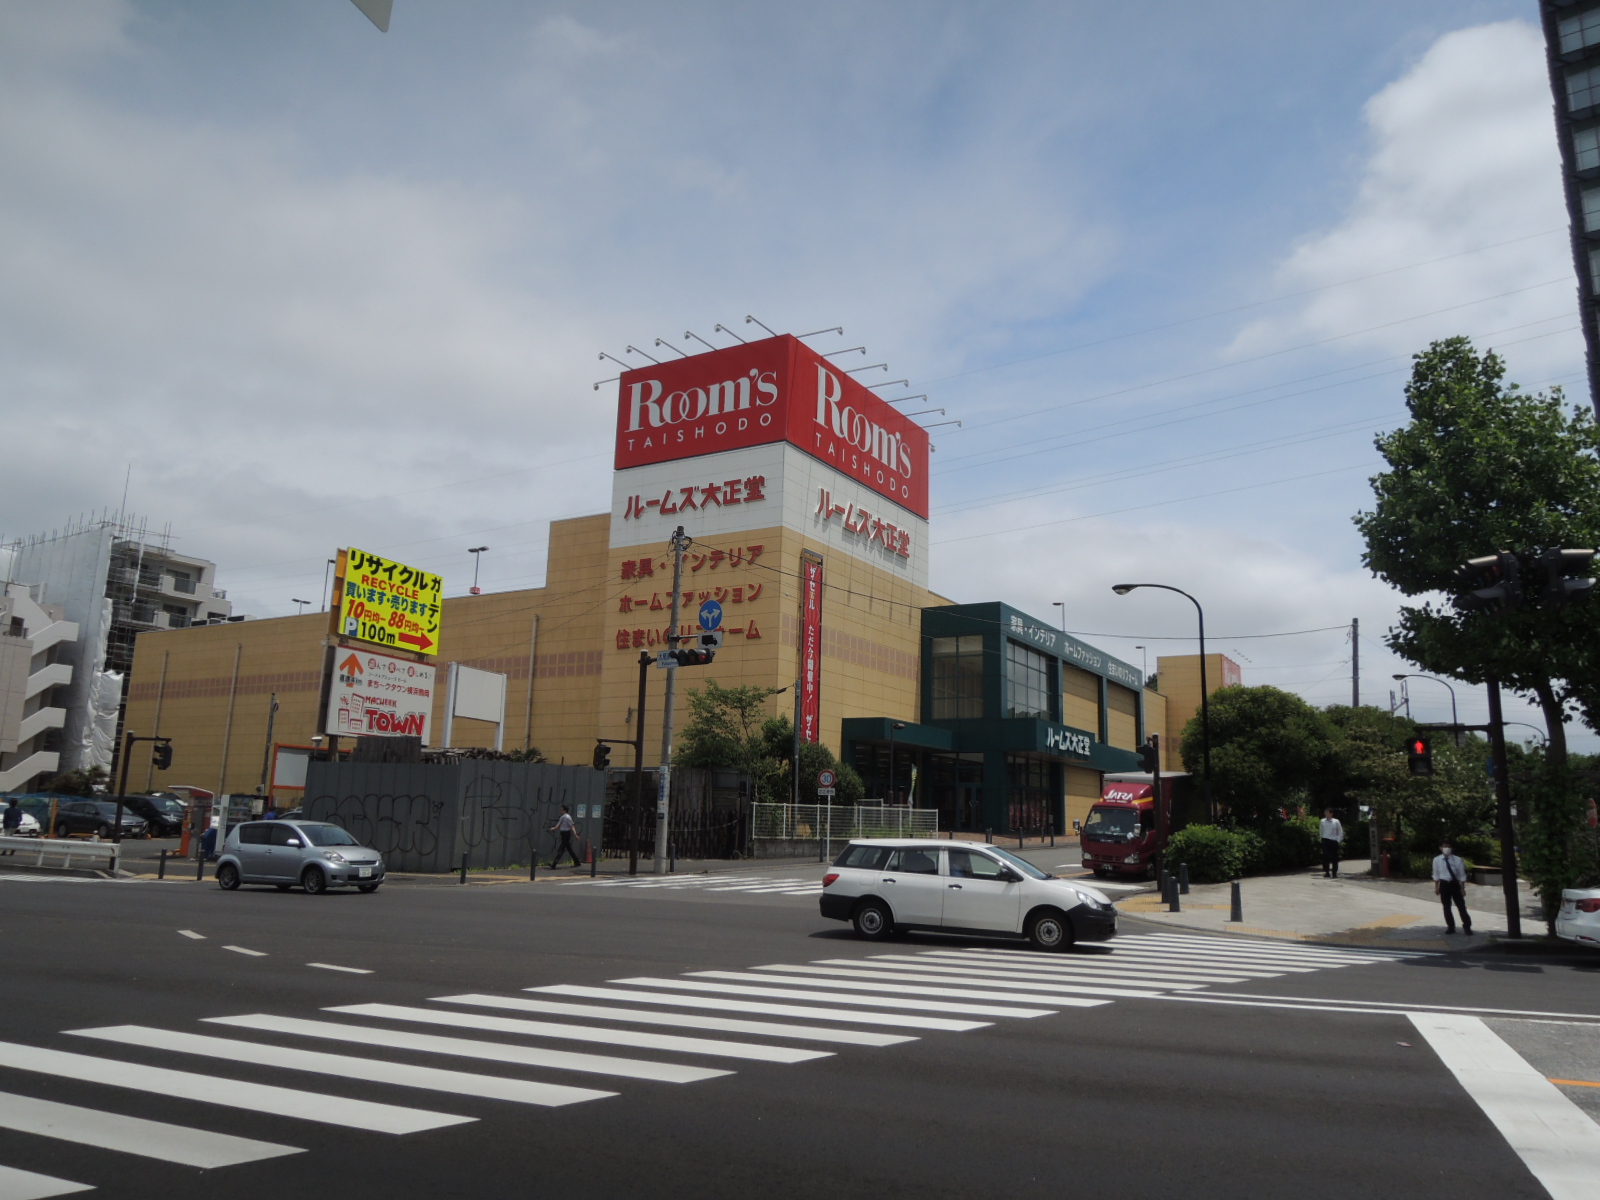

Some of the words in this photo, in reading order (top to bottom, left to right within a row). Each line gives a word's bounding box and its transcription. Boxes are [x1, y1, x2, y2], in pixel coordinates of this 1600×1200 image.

[624, 368, 778, 433] Room's
[627, 413, 772, 451] TAISHODO
[813, 361, 912, 479] Room's
[814, 432, 909, 499] TAISHODO
[624, 475, 766, 520] ルームズ大正堂
[815, 487, 911, 559] ルームズ大正堂
[345, 582, 428, 617] 買います・売ります
[350, 549, 429, 591] リサイクル
[426, 577, 442, 633] ガーデン
[361, 574, 419, 600] RECYCLE
[361, 622, 396, 644] 100m
[616, 620, 762, 649] 住まいリーム
[1010, 615, 1056, 647] 家具・インテリア
[1064, 641, 1101, 667] ホームファッション
[364, 708, 426, 736] TOWN
[1046, 727, 1091, 756] ルームズ大正堂
[821, 774, 832, 783] 30
